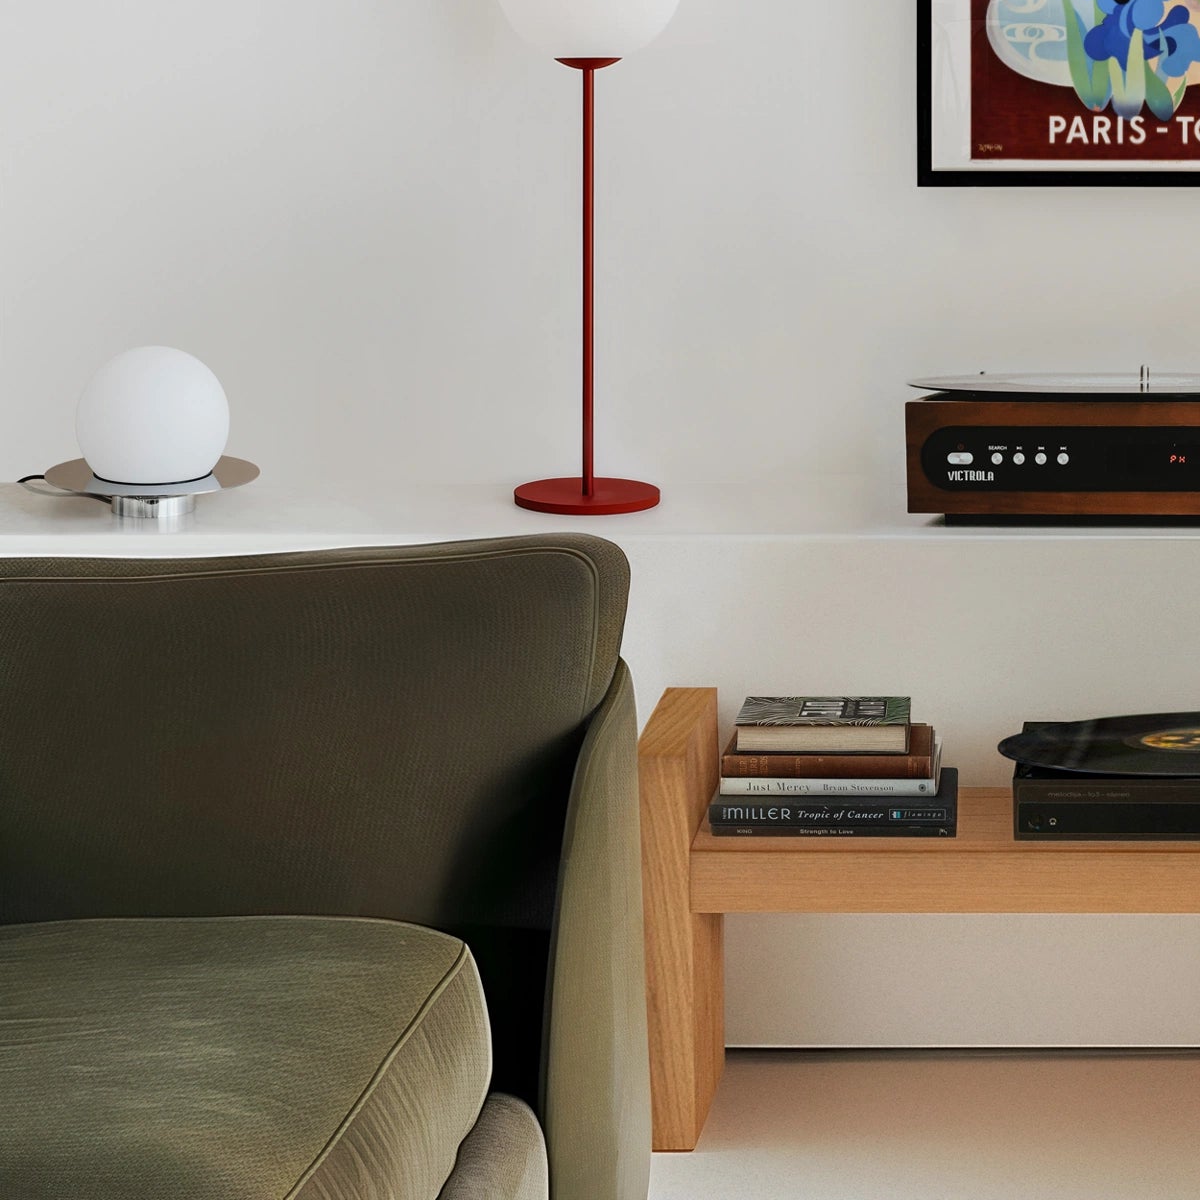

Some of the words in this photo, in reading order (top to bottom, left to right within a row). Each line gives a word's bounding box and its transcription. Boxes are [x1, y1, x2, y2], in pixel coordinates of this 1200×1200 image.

[1048, 116, 1146, 145] PARIS
[947, 470, 994, 482] VICTROLA
[746, 782, 771, 792] Just
[776, 782, 811, 794] Mercy
[823, 784, 848, 793] Bryan
[851, 784, 894, 792] Stevenson
[728, 808, 791, 820] MILLER
[798, 810, 830, 820] Tropic
[833, 810, 845, 820] of
[847, 810, 884, 819] Cancer
[903, 810, 942, 818] flamingo
